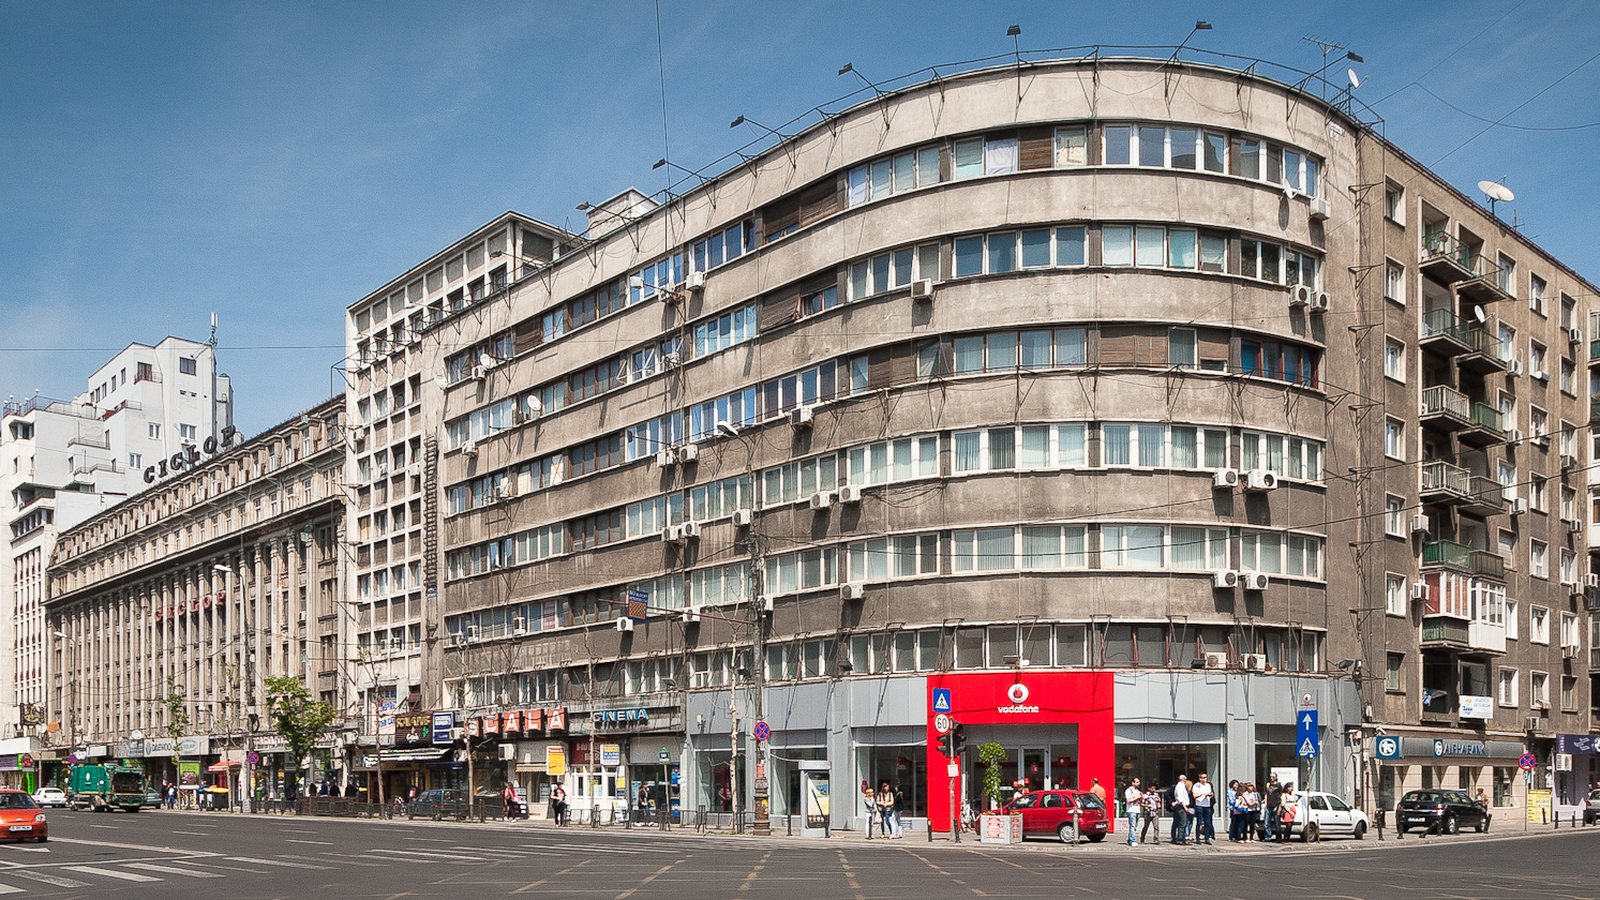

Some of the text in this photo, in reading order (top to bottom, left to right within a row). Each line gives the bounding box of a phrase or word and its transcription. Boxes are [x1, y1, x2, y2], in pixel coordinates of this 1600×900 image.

[143, 424, 236, 484] CICLOP
[155, 590, 226, 622] CICLOP
[592, 708, 649, 722] CINEMA
[997, 705, 1039, 713] vodafone
[467, 711, 564, 736] SCALA
[936, 717, 947, 729] 60
